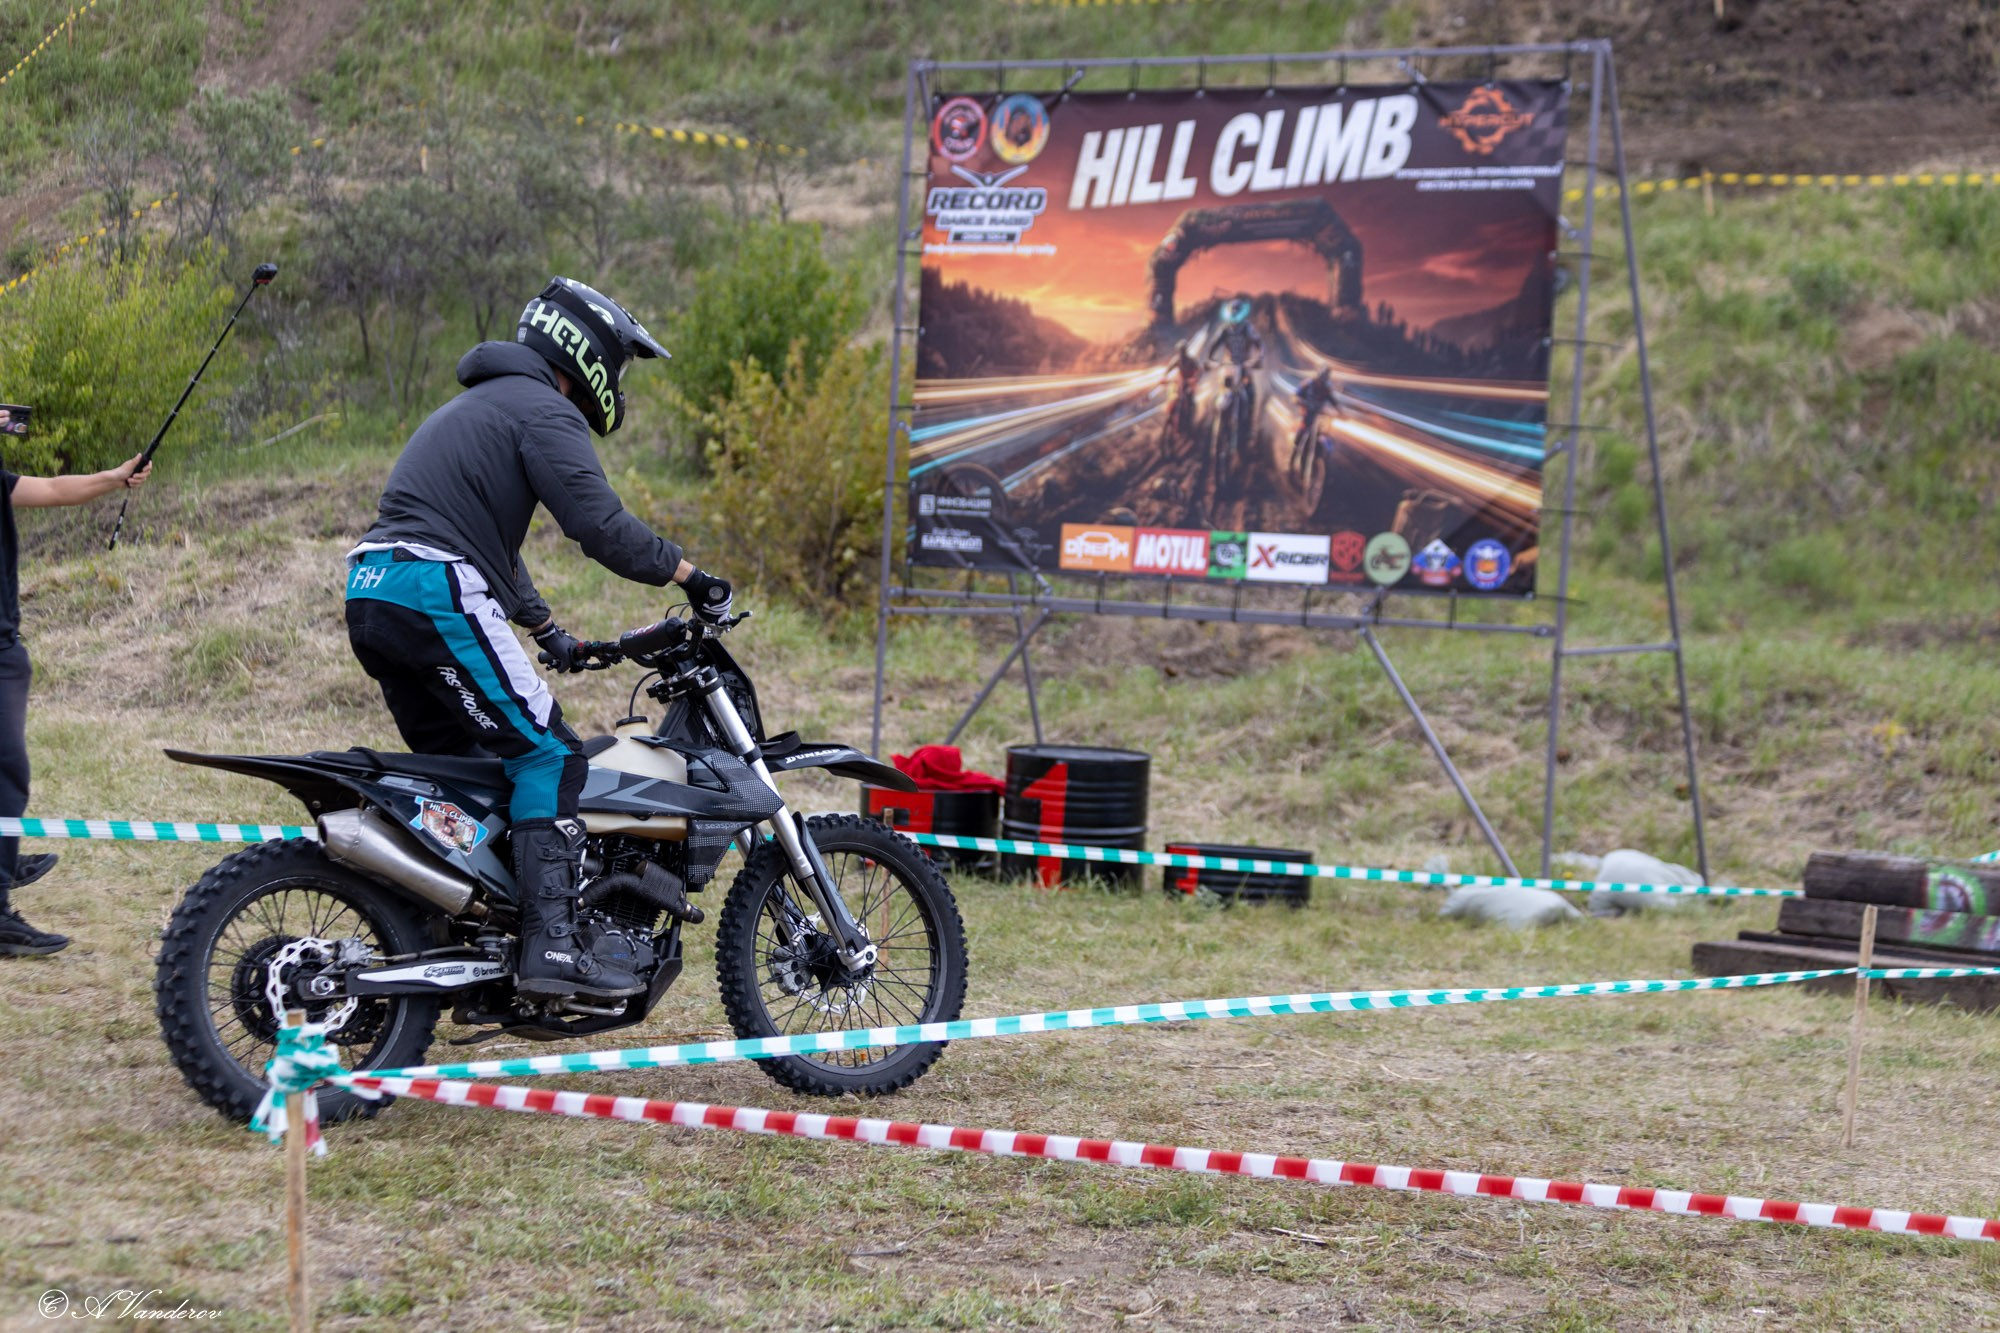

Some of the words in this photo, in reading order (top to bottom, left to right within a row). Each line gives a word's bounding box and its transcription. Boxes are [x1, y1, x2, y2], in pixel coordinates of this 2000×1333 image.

[1068, 120, 1198, 210] HILL
[1210, 95, 1418, 196] CLIMB
[930, 189, 1044, 210] RECORD
[1134, 533, 1207, 571] MOTUL
[785, 748, 840, 764] DUNLOP
[429, 802, 448, 815] HILL
[442, 816, 457, 837] 5
[705, 822, 741, 831] seaspan
